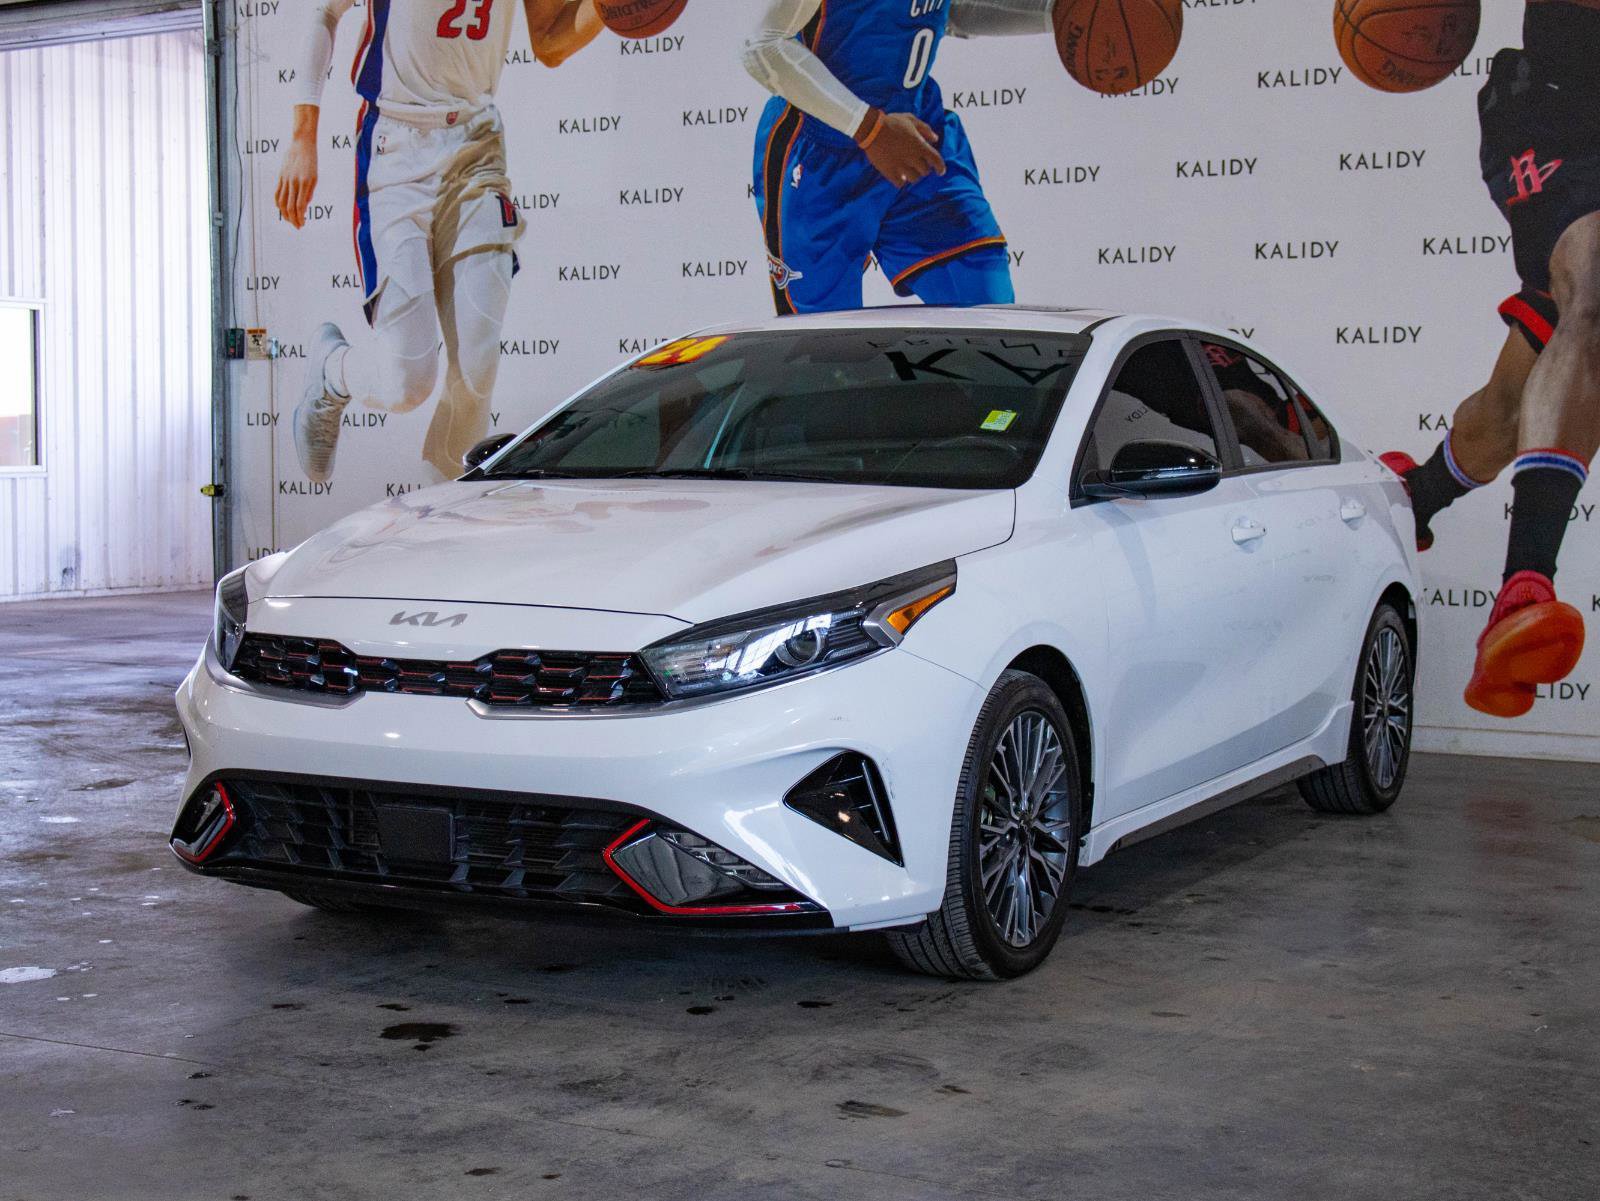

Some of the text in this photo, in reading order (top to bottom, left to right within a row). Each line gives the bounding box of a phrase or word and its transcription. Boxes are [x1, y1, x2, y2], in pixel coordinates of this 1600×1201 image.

[436, 0, 493, 40] 23
[620, 36, 685, 55] KALIDY
[1257, 67, 1343, 89] KALIDY
[953, 87, 1027, 109] KALIDY
[558, 115, 621, 134] KALIDY
[683, 106, 749, 126] KALIDY
[246, 139, 280, 154] LIDY
[1176, 157, 1257, 178] KALIDY
[1339, 149, 1426, 171] KALIDY
[1024, 165, 1101, 185] KALIDY
[512, 193, 560, 210] ALIDY
[619, 187, 684, 205] KALIDY
[1254, 240, 1339, 260] KALIDY
[1423, 235, 1512, 255] KALIDY
[1098, 245, 1176, 265] KALIDY
[558, 265, 621, 281] KALIDY
[682, 260, 748, 278] KALIDY
[246, 276, 280, 290] LIDY
[332, 274, 361, 288] KAL
[1336, 326, 1422, 345] KALIDY
[278, 344, 307, 358] KAL
[499, 340, 560, 356] KALIDY
[246, 412, 280, 426] LIDY
[342, 412, 388, 427] ALIDY
[279, 480, 333, 496] KALIDY
[1534, 682, 1591, 701] LIDY
